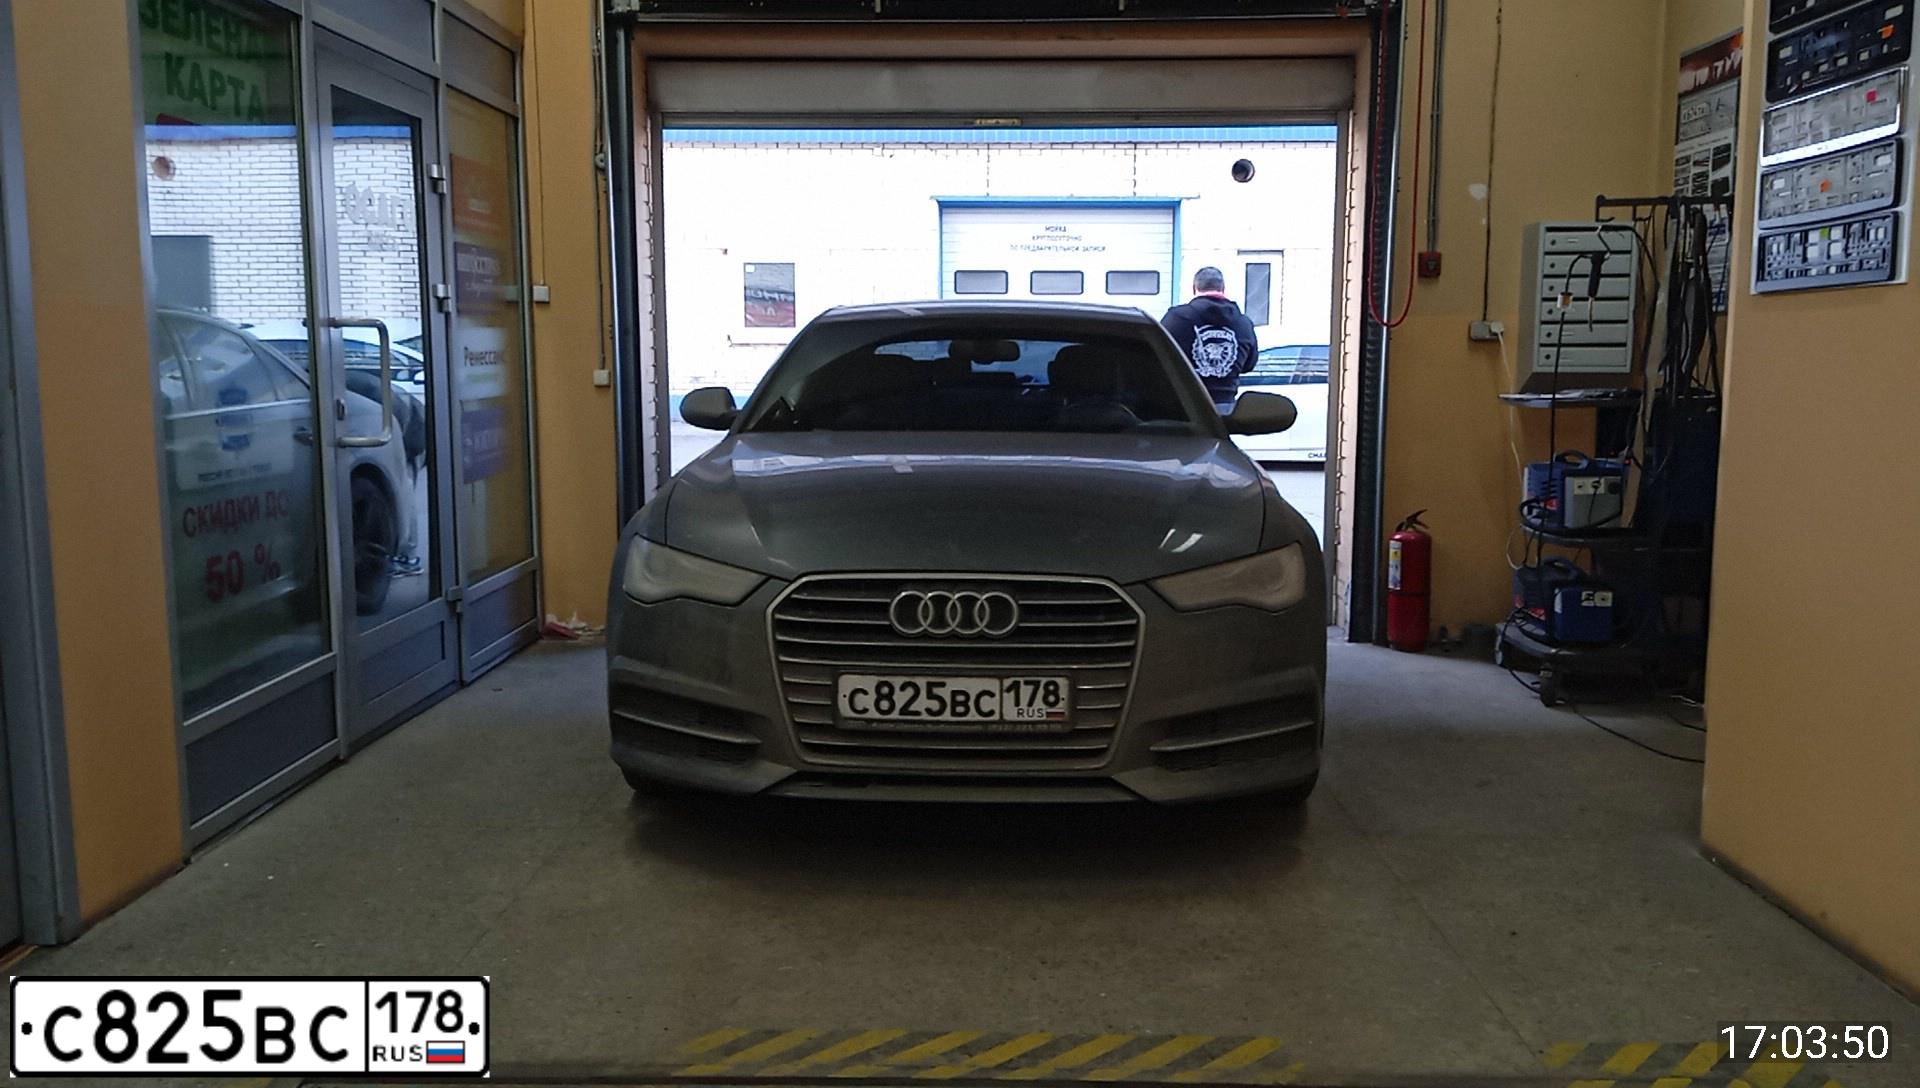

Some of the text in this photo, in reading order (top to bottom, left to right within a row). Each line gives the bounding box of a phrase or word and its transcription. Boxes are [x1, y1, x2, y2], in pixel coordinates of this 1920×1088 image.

[164, 51, 264, 120] КАРТА
[183, 496, 259, 538] СКИДКИ
[206, 543, 281, 603] 50 %
[1004, 680, 1060, 707] 178
[1017, 709, 1044, 718] RUS
